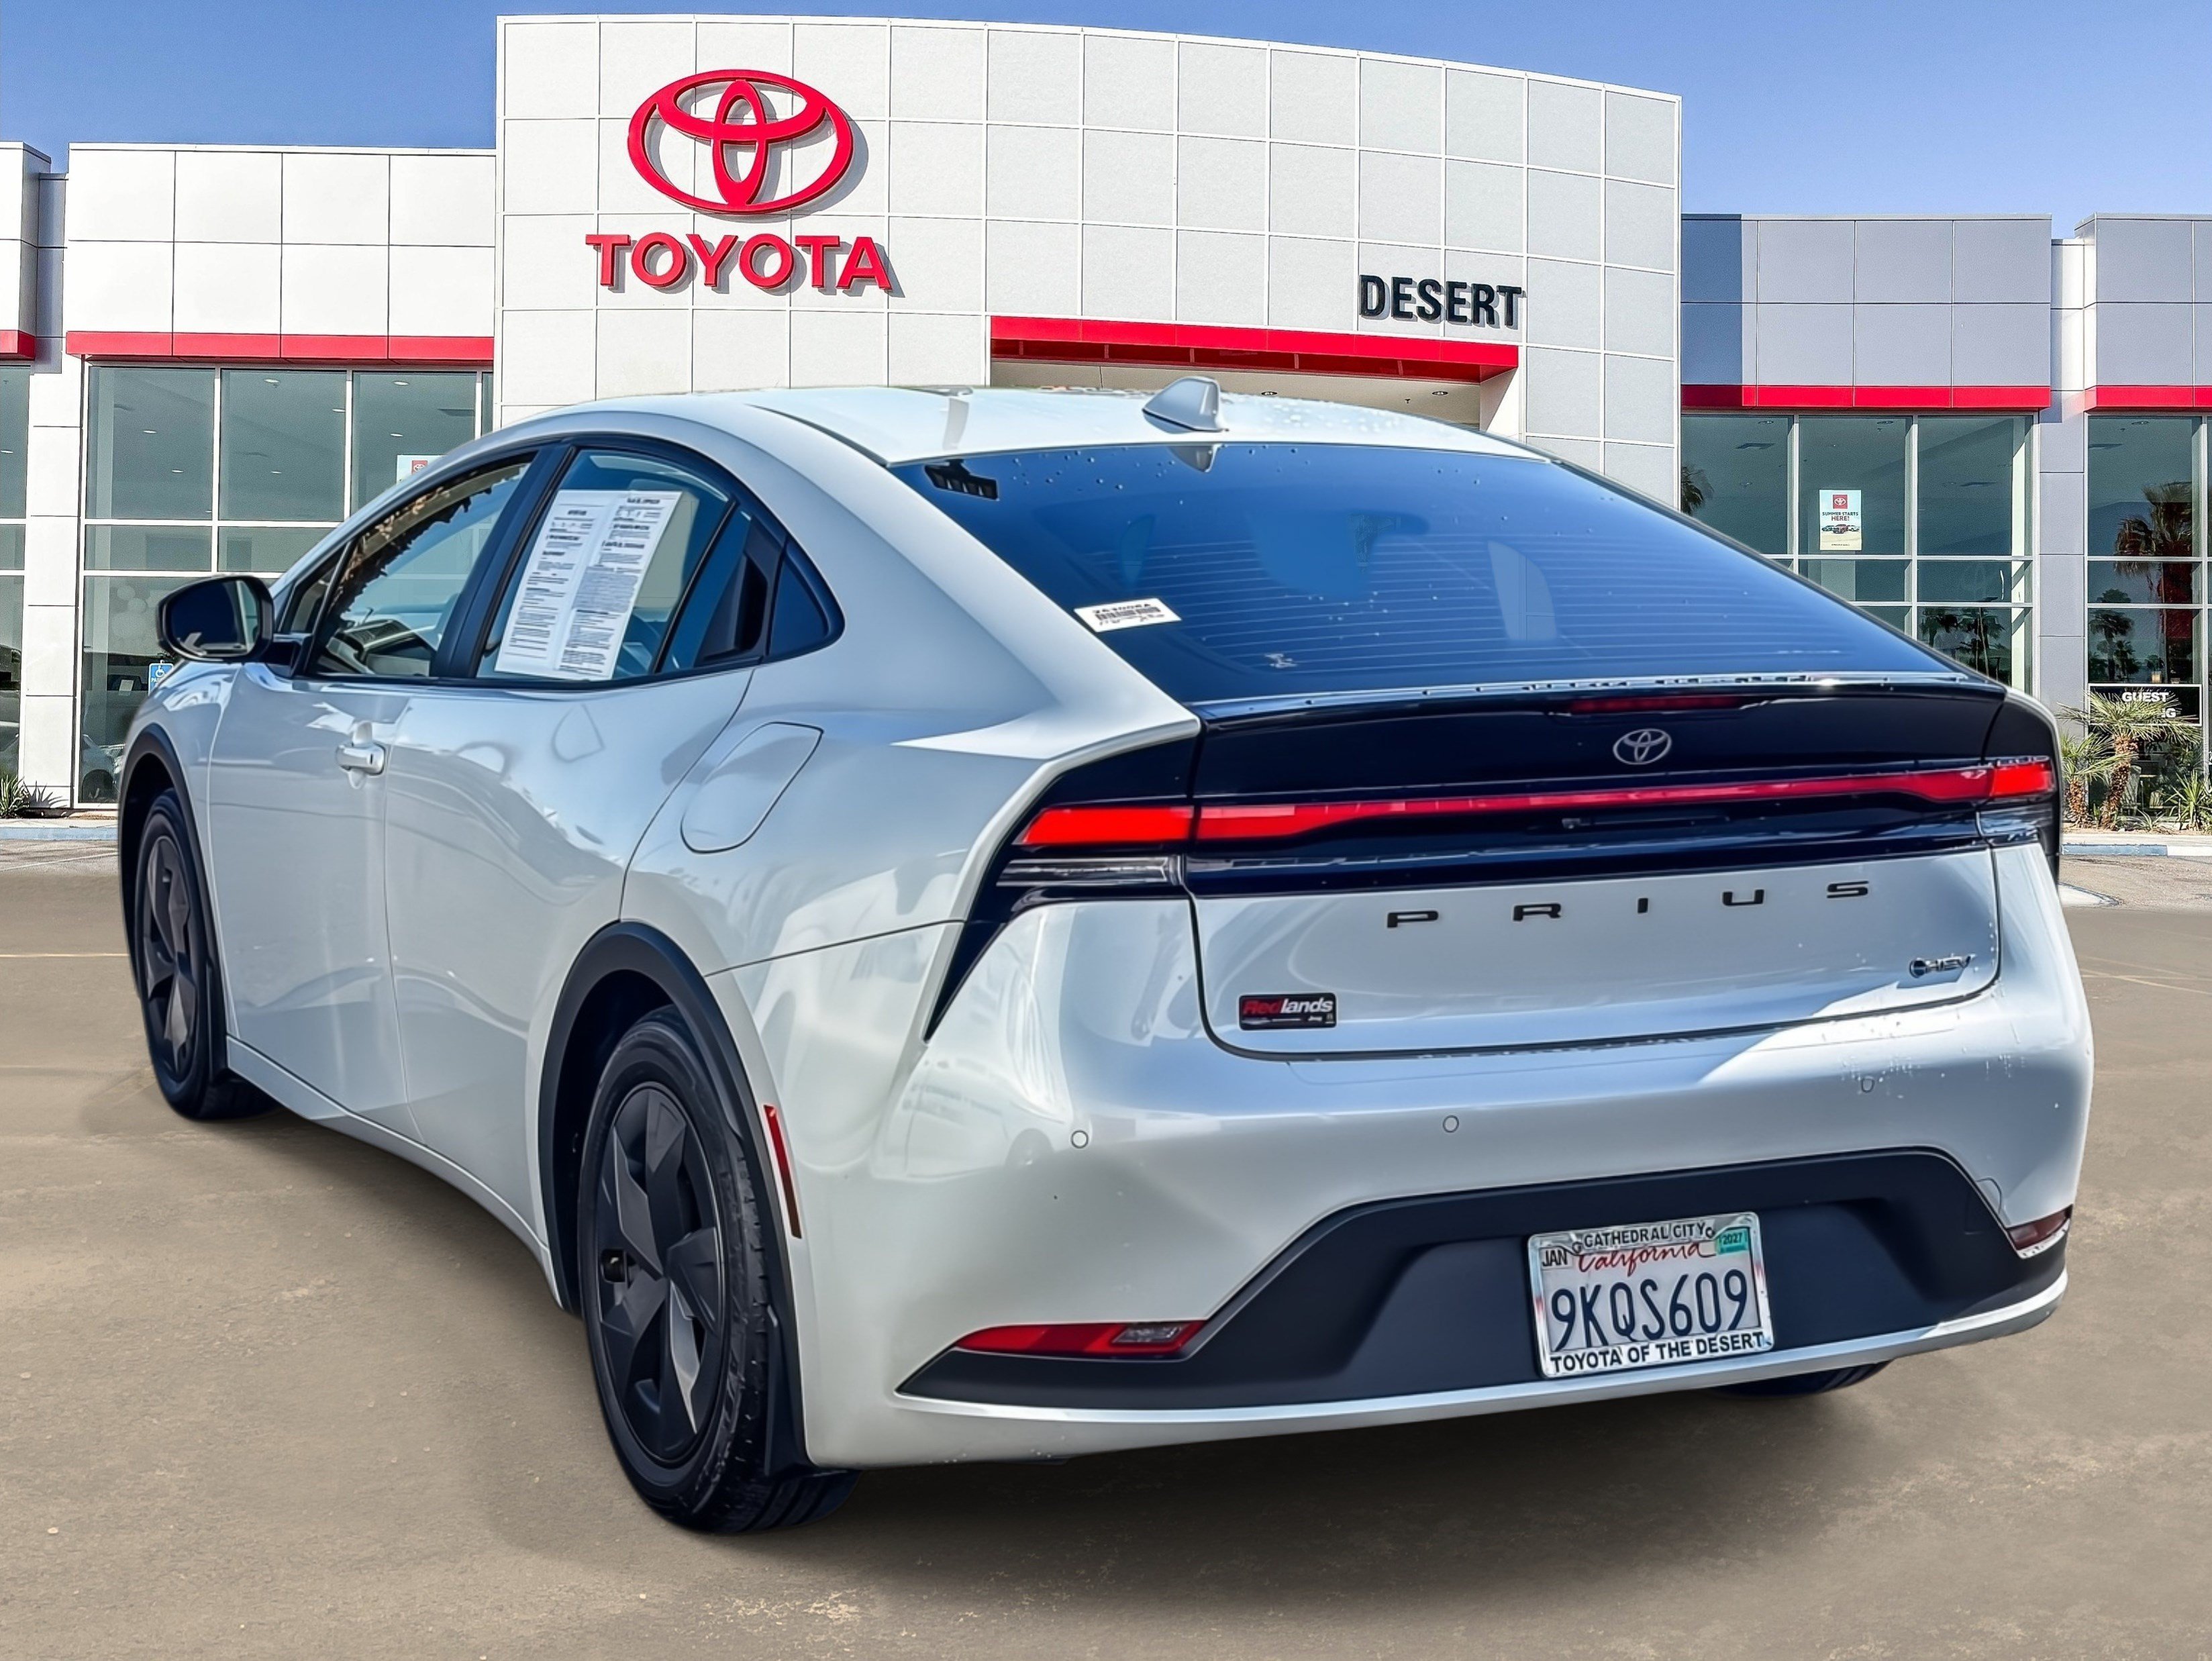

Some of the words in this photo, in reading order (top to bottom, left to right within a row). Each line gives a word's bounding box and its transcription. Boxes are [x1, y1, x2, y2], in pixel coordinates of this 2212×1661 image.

[585, 232, 893, 291] TOYOTA
[1359, 274, 1523, 326] DESERT
[2121, 692, 2169, 702] GUEST
[1387, 880, 1869, 928] PRIUS
[1243, 997, 1334, 1015] Redlands
[1543, 1248, 1568, 1267] JAN
[1578, 1242, 1717, 1276] California
[1723, 1232, 1743, 1245] 2027
[1584, 1230, 1669, 1248] CATHEDRAL
[1673, 1222, 1706, 1238] CITY
[1551, 1269, 1746, 1352] 9KQS609
[1551, 1350, 1622, 1373] TOYOTA
[1628, 1346, 1650, 1363] OF
[1656, 1342, 1691, 1360] THE
[1697, 1331, 1763, 1355] DESERT
